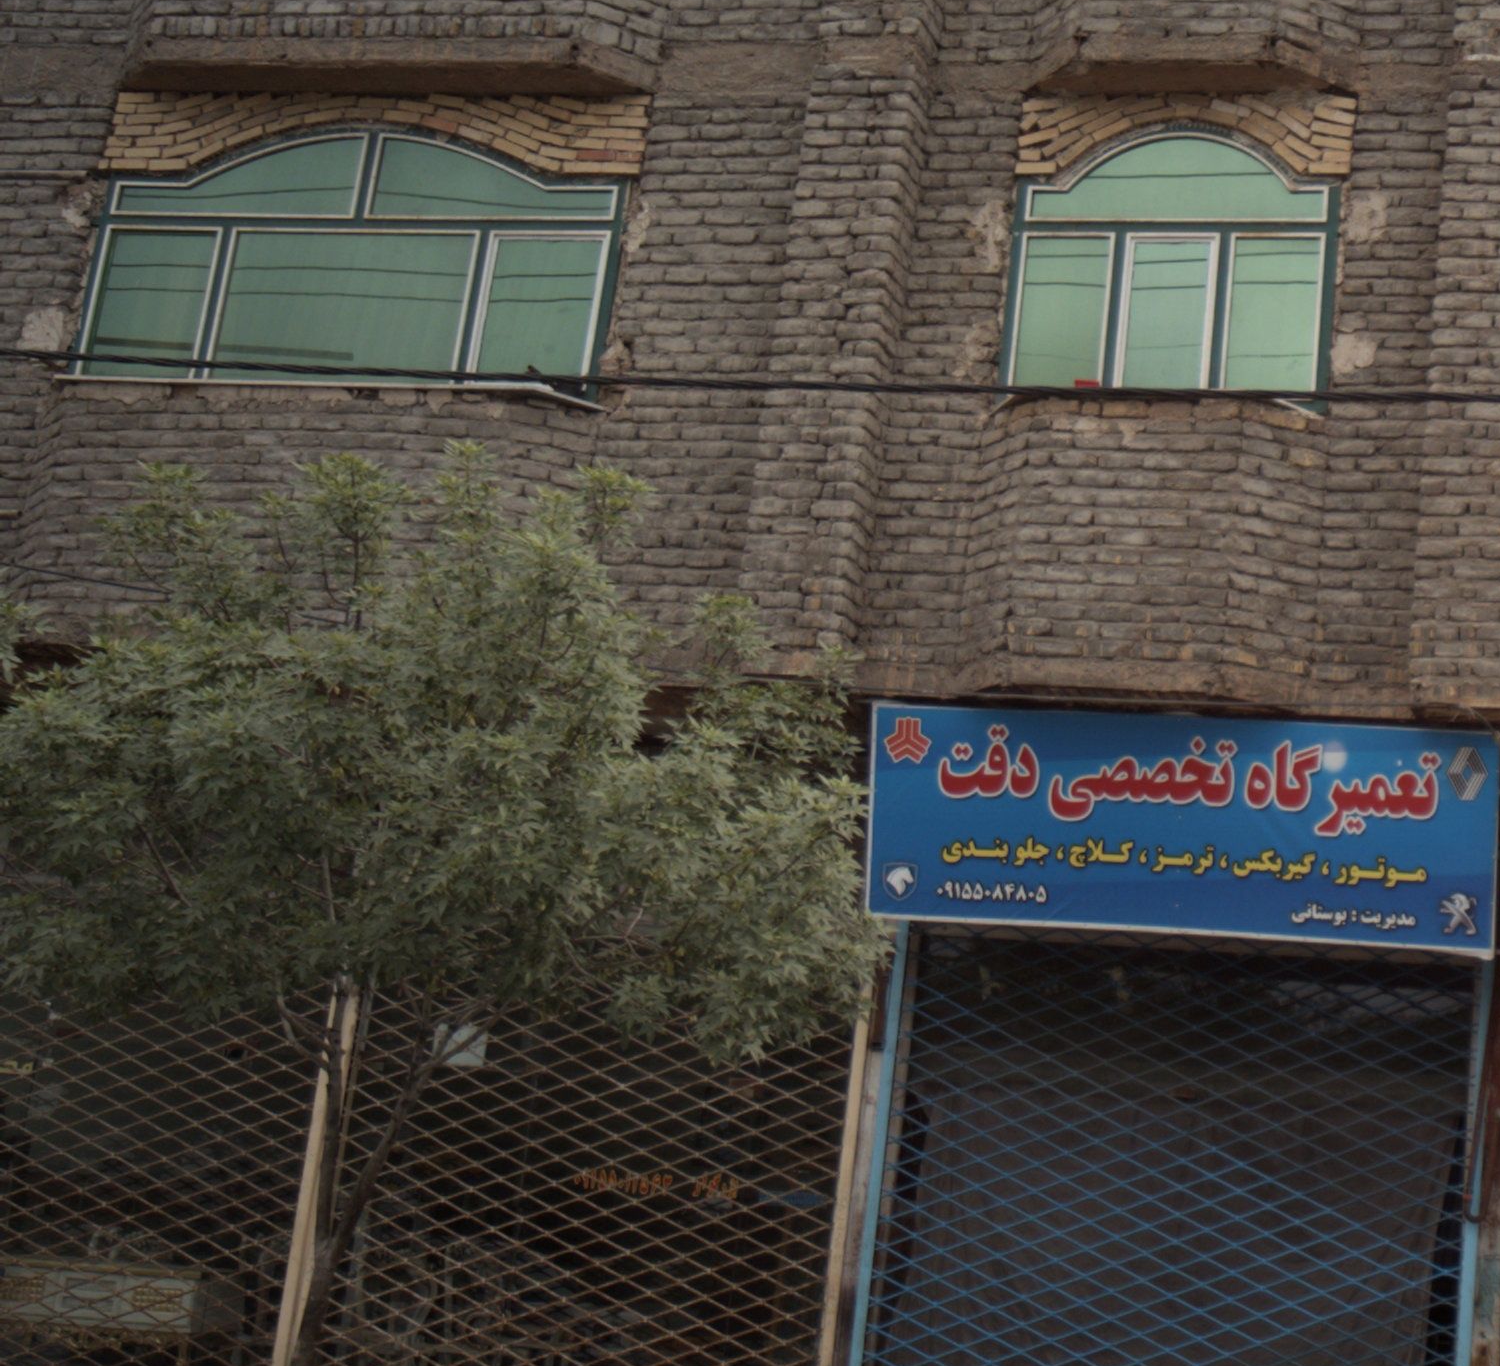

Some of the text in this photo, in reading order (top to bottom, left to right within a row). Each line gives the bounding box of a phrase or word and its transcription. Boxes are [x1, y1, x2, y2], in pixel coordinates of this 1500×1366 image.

[938, 725, 1040, 798] دقت
[1049, 735, 1238, 821] تخصصی
[1068, 837, 1135, 869] کلاچ
[1152, 846, 1215, 875] ترمز
[1231, 848, 1317, 882] گیربکس
[1332, 855, 1428, 889] موتور
[936, 880, 1048, 904] ۰۹۱۵۵۰۸۴۸۰۵
[1290, 902, 1349, 927] بوستانی
[1360, 910, 1417, 931] مدیریت
